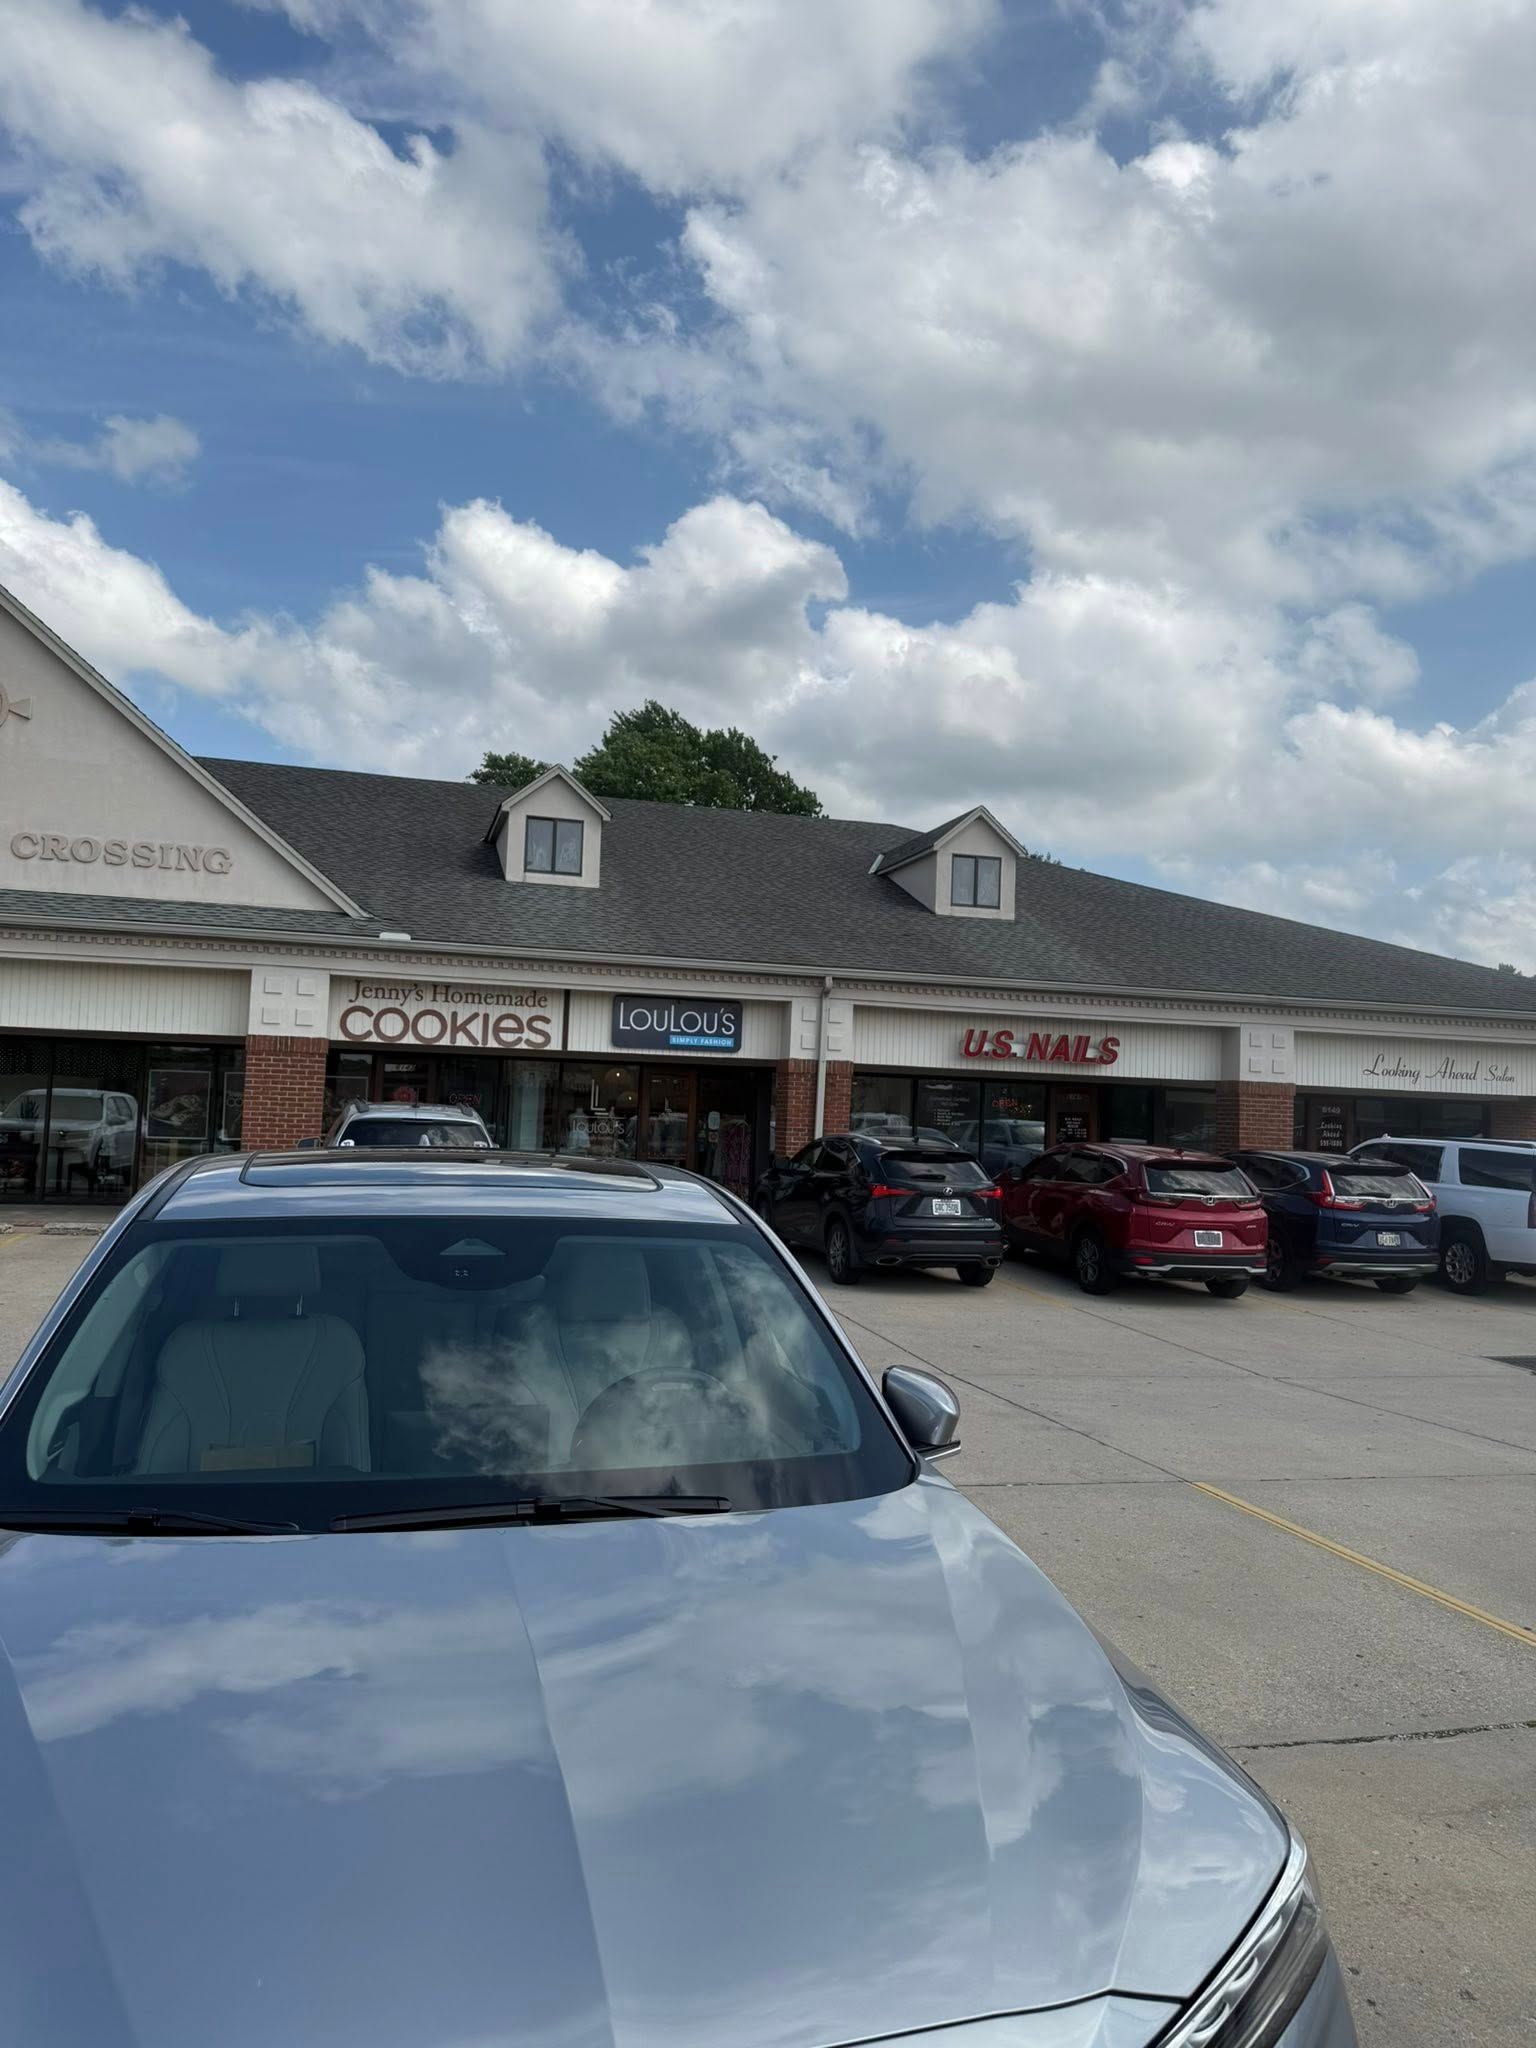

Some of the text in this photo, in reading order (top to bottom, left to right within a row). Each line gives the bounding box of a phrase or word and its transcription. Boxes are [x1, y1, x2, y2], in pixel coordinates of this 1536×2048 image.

[10, 831, 233, 875] CROSSING
[348, 979, 548, 1008] Jenny's Homemade
[671, 1036, 733, 1047] SIMPLY FASHION
[961, 1028, 1121, 1066] U.S. NAILS
[1362, 1053, 1515, 1085] Looking Ahead Salon
